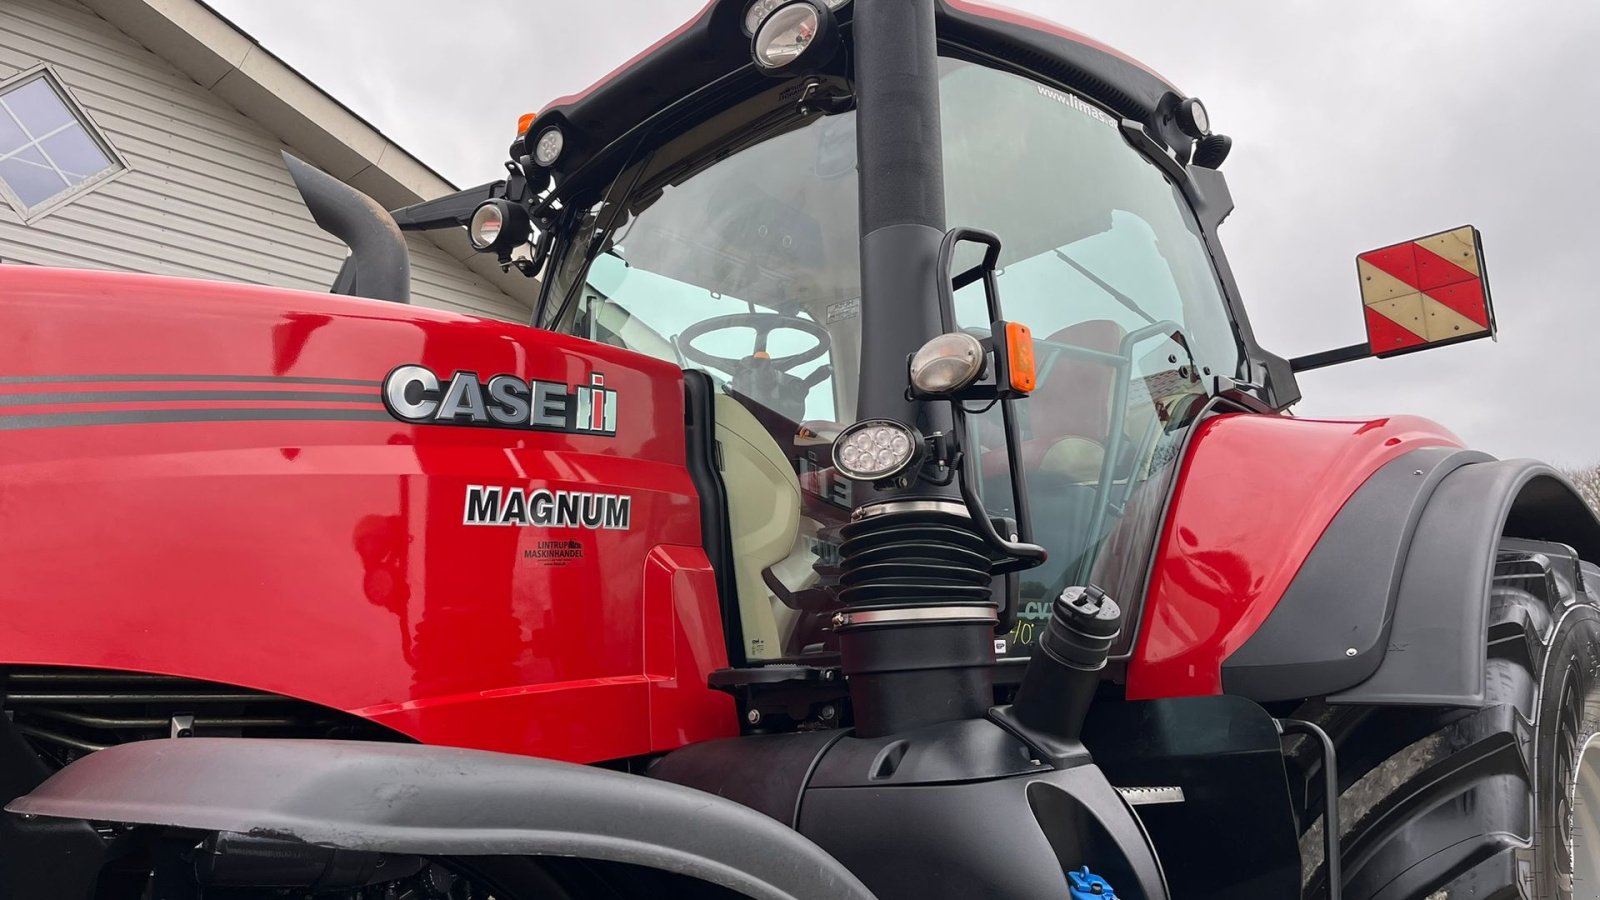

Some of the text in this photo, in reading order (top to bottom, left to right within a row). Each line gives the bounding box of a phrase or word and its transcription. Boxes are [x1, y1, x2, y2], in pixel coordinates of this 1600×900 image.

[384, 364, 568, 428] CASE
[463, 484, 631, 530] MAGNUM
[524, 549, 583, 558] MASKINHANDEL
[537, 541, 569, 550] LINTRUP
[1024, 601, 1054, 620] CV
